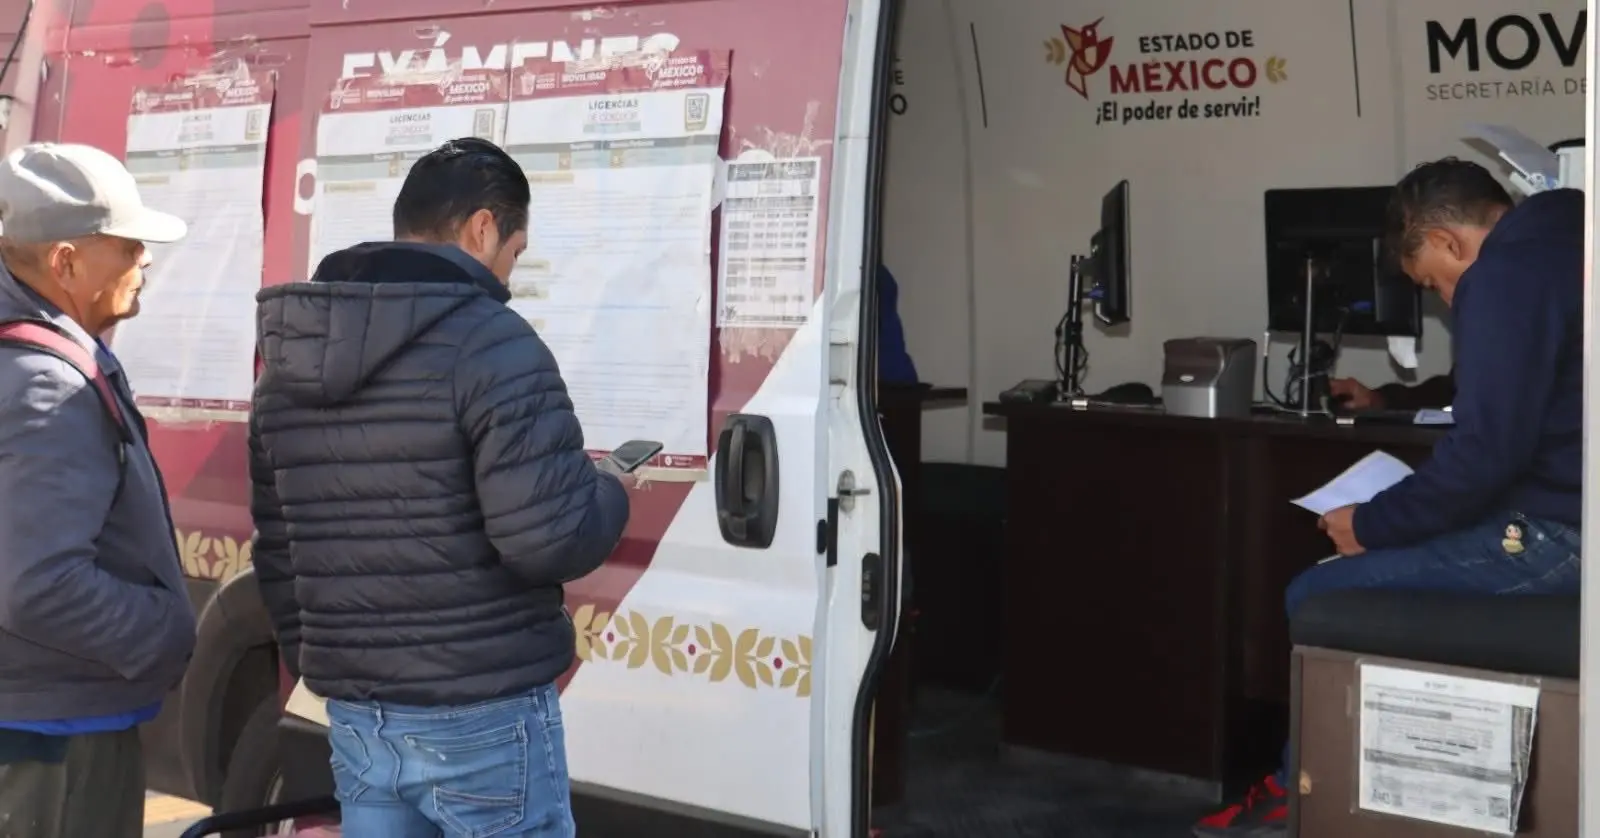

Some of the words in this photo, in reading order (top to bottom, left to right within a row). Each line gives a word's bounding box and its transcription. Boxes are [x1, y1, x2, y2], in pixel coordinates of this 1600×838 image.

[1139, 32, 1220, 53] ESTADO
[1225, 30, 1254, 48] DE
[1109, 57, 1257, 94] MÉXICO
[1426, 77, 1556, 100] SECRETARÍA
[1096, 101, 1117, 125] ¡El
[1123, 100, 1172, 125] poder
[1177, 98, 1199, 119] de
[1203, 96, 1260, 118] servir!
